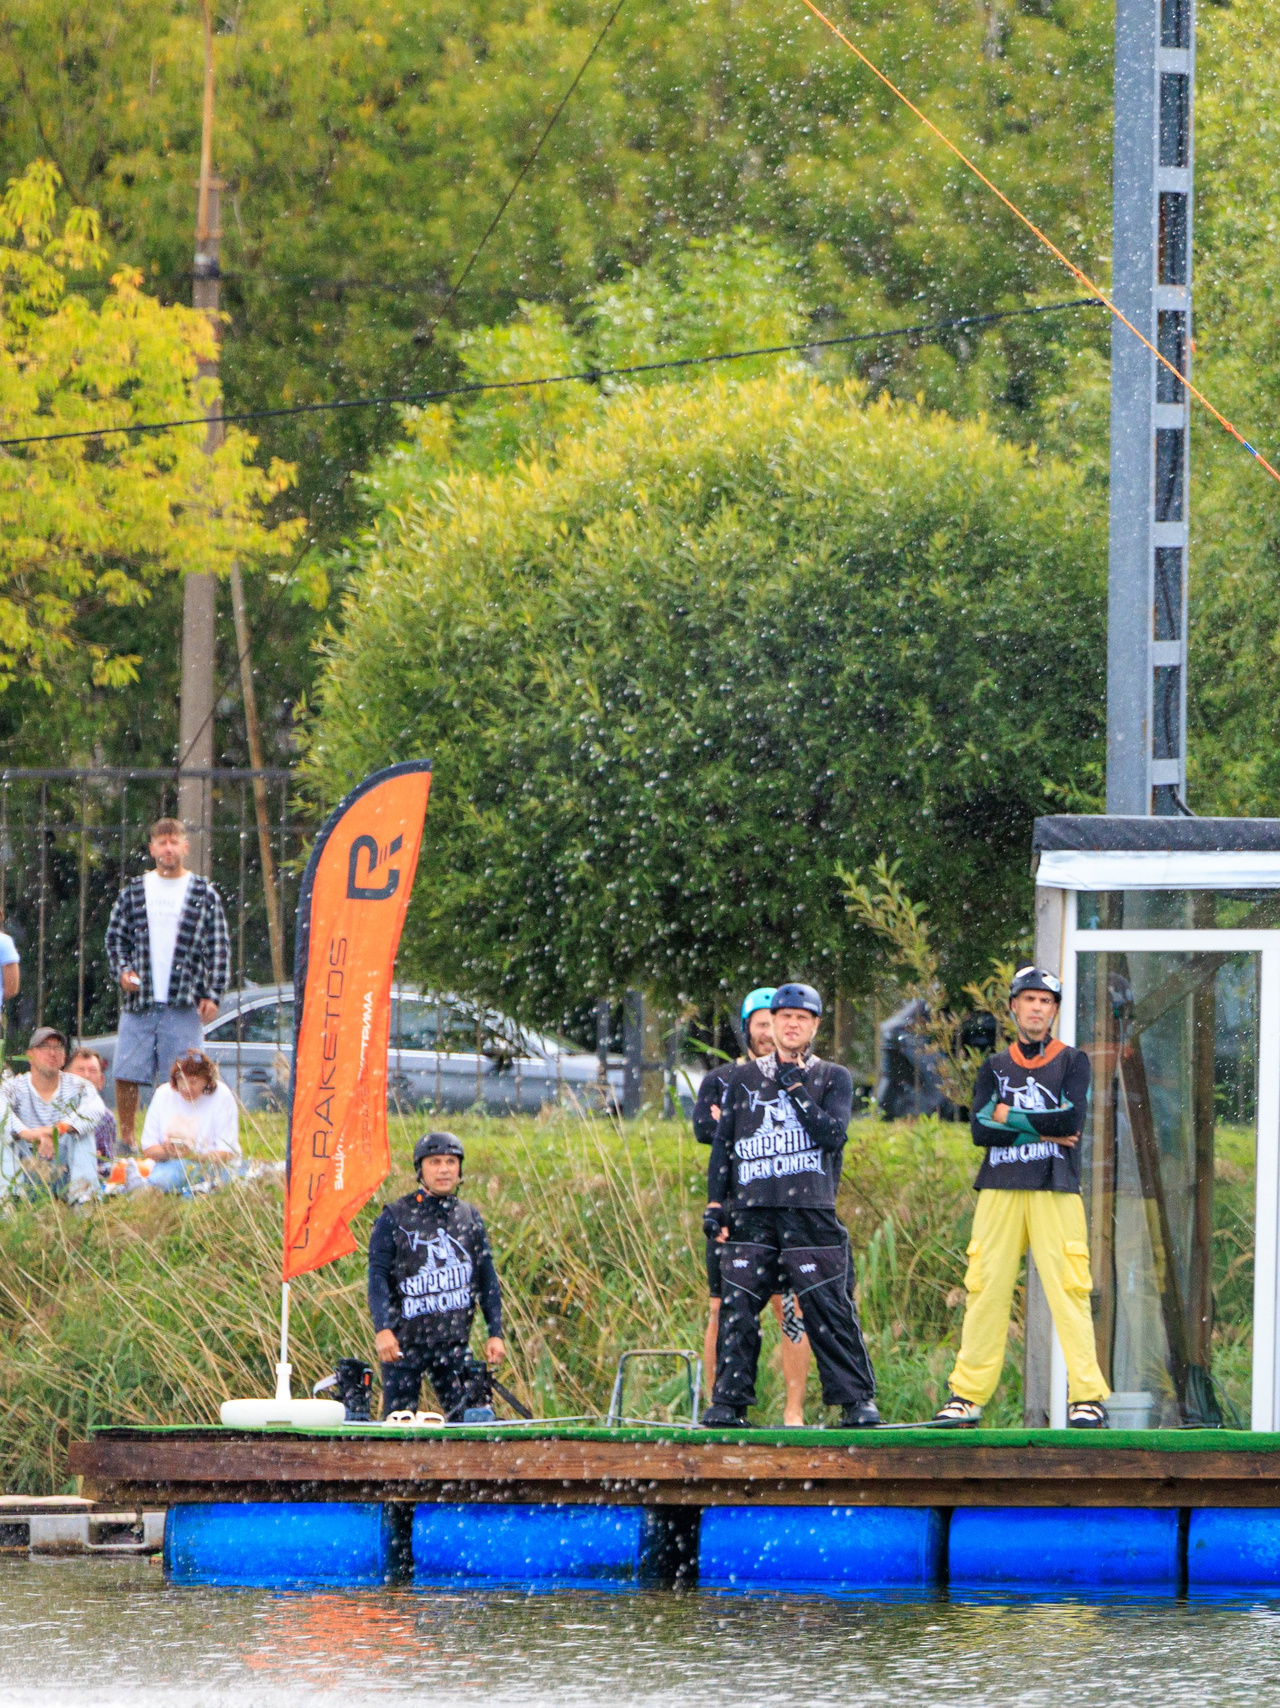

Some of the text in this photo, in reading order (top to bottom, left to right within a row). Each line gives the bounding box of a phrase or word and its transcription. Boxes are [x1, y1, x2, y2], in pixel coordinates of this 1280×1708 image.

[292, 938, 347, 1250] LS RAKETOS
[735, 1127, 818, 1160] KUPCHIN
[738, 1149, 826, 1186] OPEN CONTEST
[401, 1295, 437, 1320] OPEN
